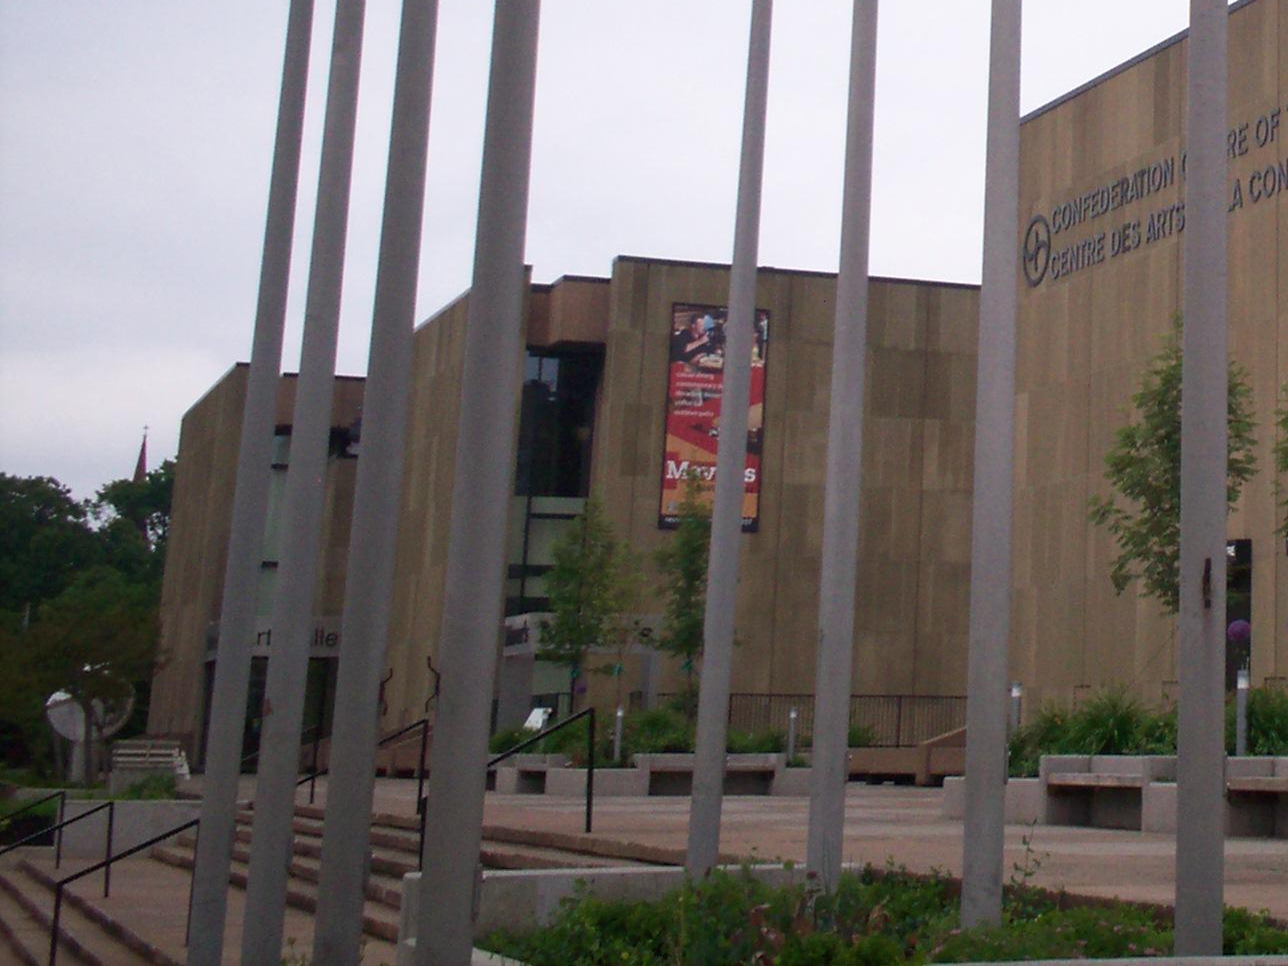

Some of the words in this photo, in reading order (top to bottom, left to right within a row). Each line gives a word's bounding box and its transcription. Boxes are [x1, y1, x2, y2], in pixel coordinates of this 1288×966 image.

[1052, 155, 1175, 235] CONFEDERATION
[1256, 107, 1281, 148] OF
[1050, 233, 1106, 280] CENTRE
[1110, 220, 1142, 259] DES
[1145, 202, 1186, 245] ARTS
